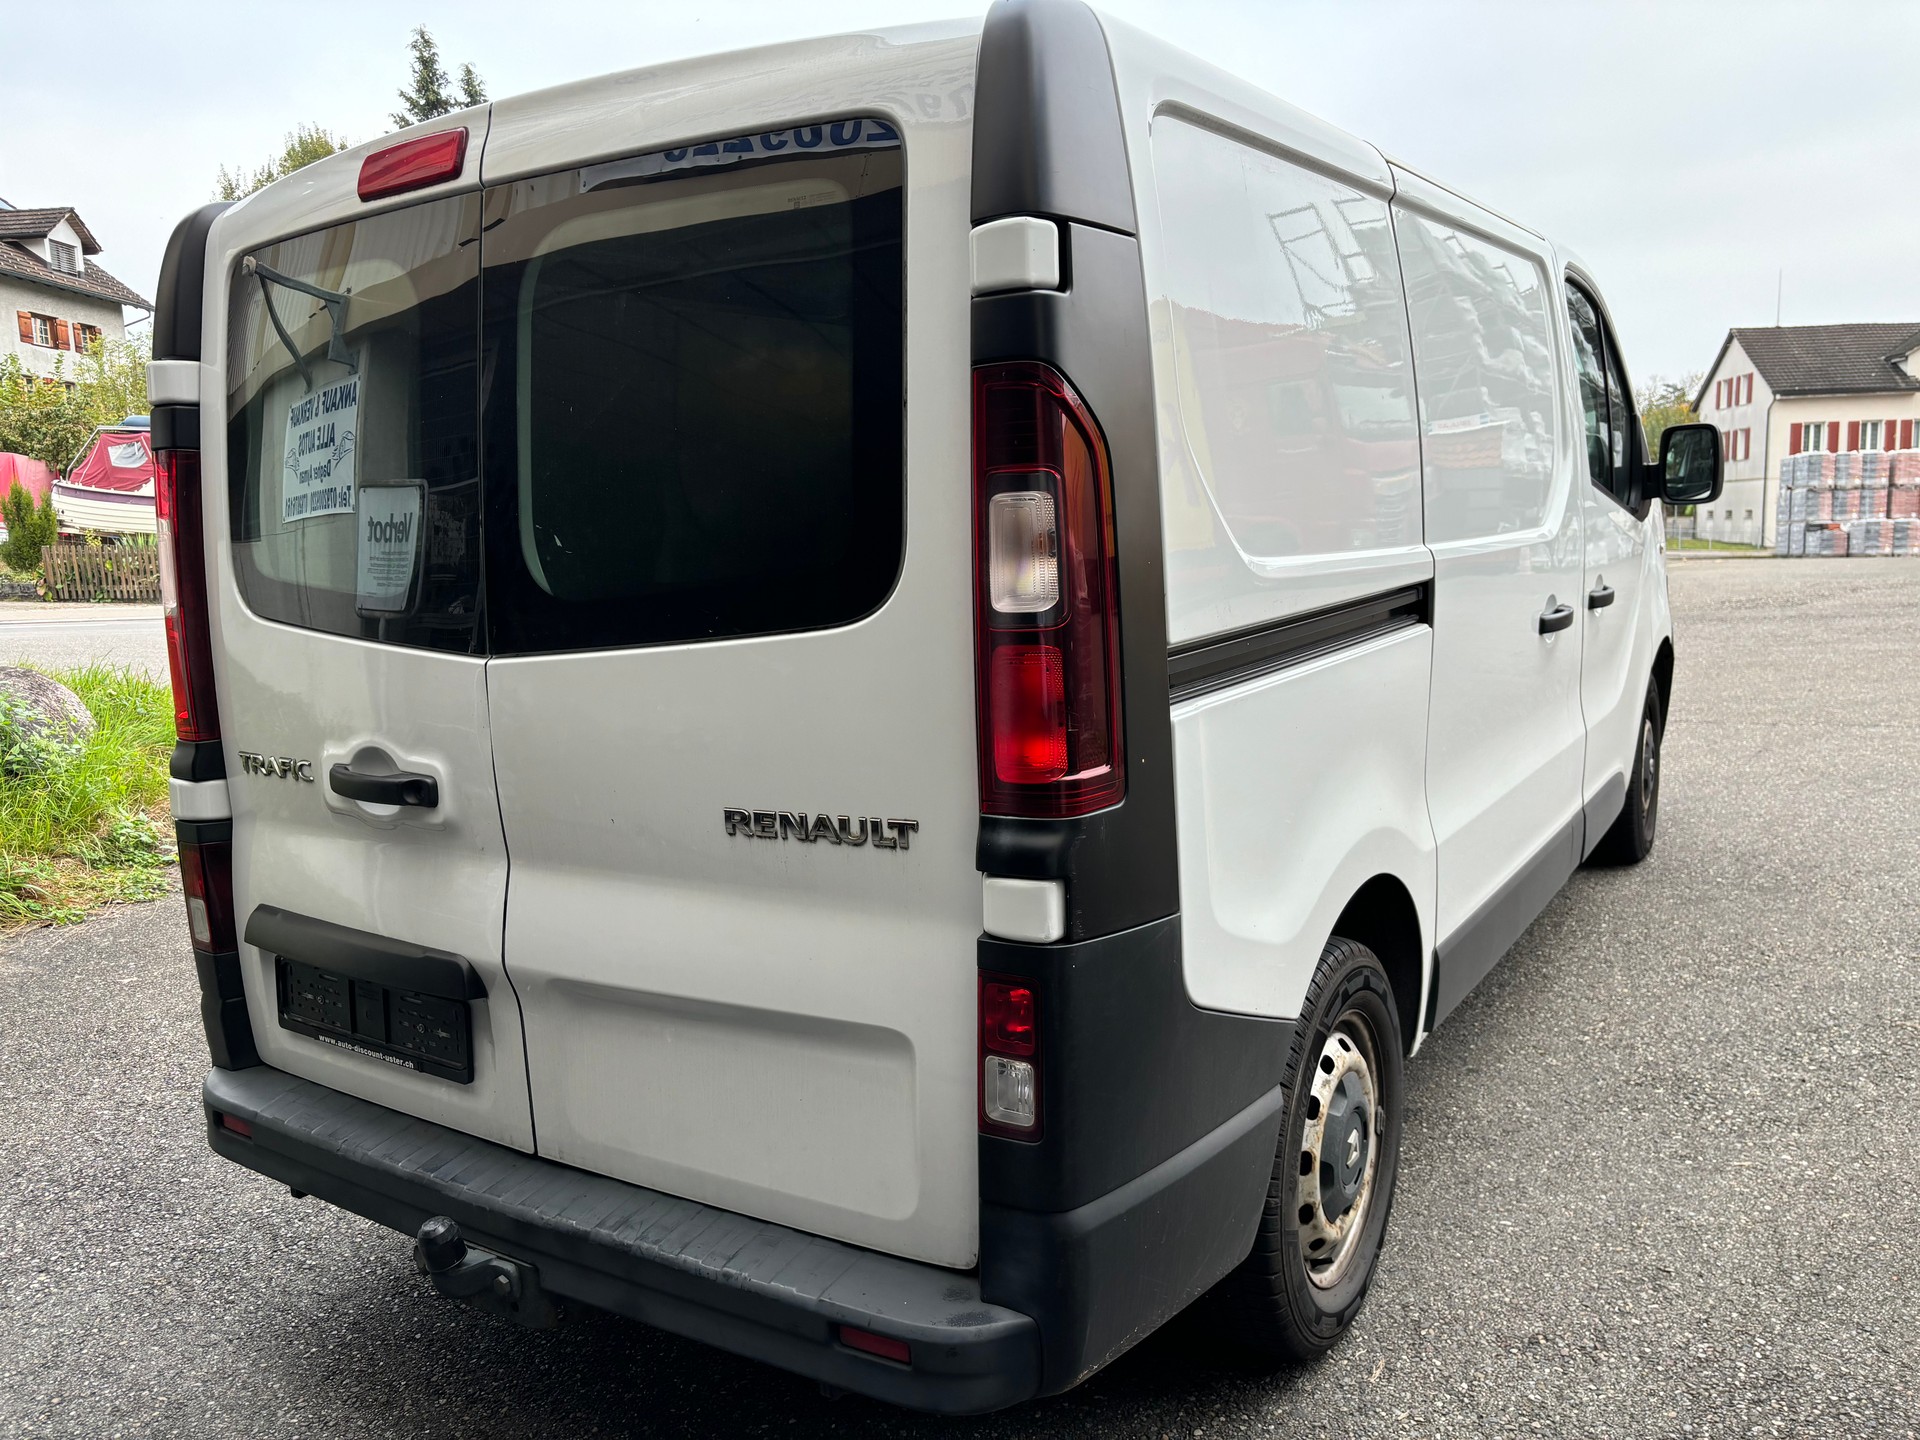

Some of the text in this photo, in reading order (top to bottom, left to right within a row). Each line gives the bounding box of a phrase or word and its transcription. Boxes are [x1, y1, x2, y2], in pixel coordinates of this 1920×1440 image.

[238, 751, 314, 782] TRAFIC
[723, 806, 919, 850] RENAULT
[318, 1034, 415, 1069] www.auto-discount-uster.ch
